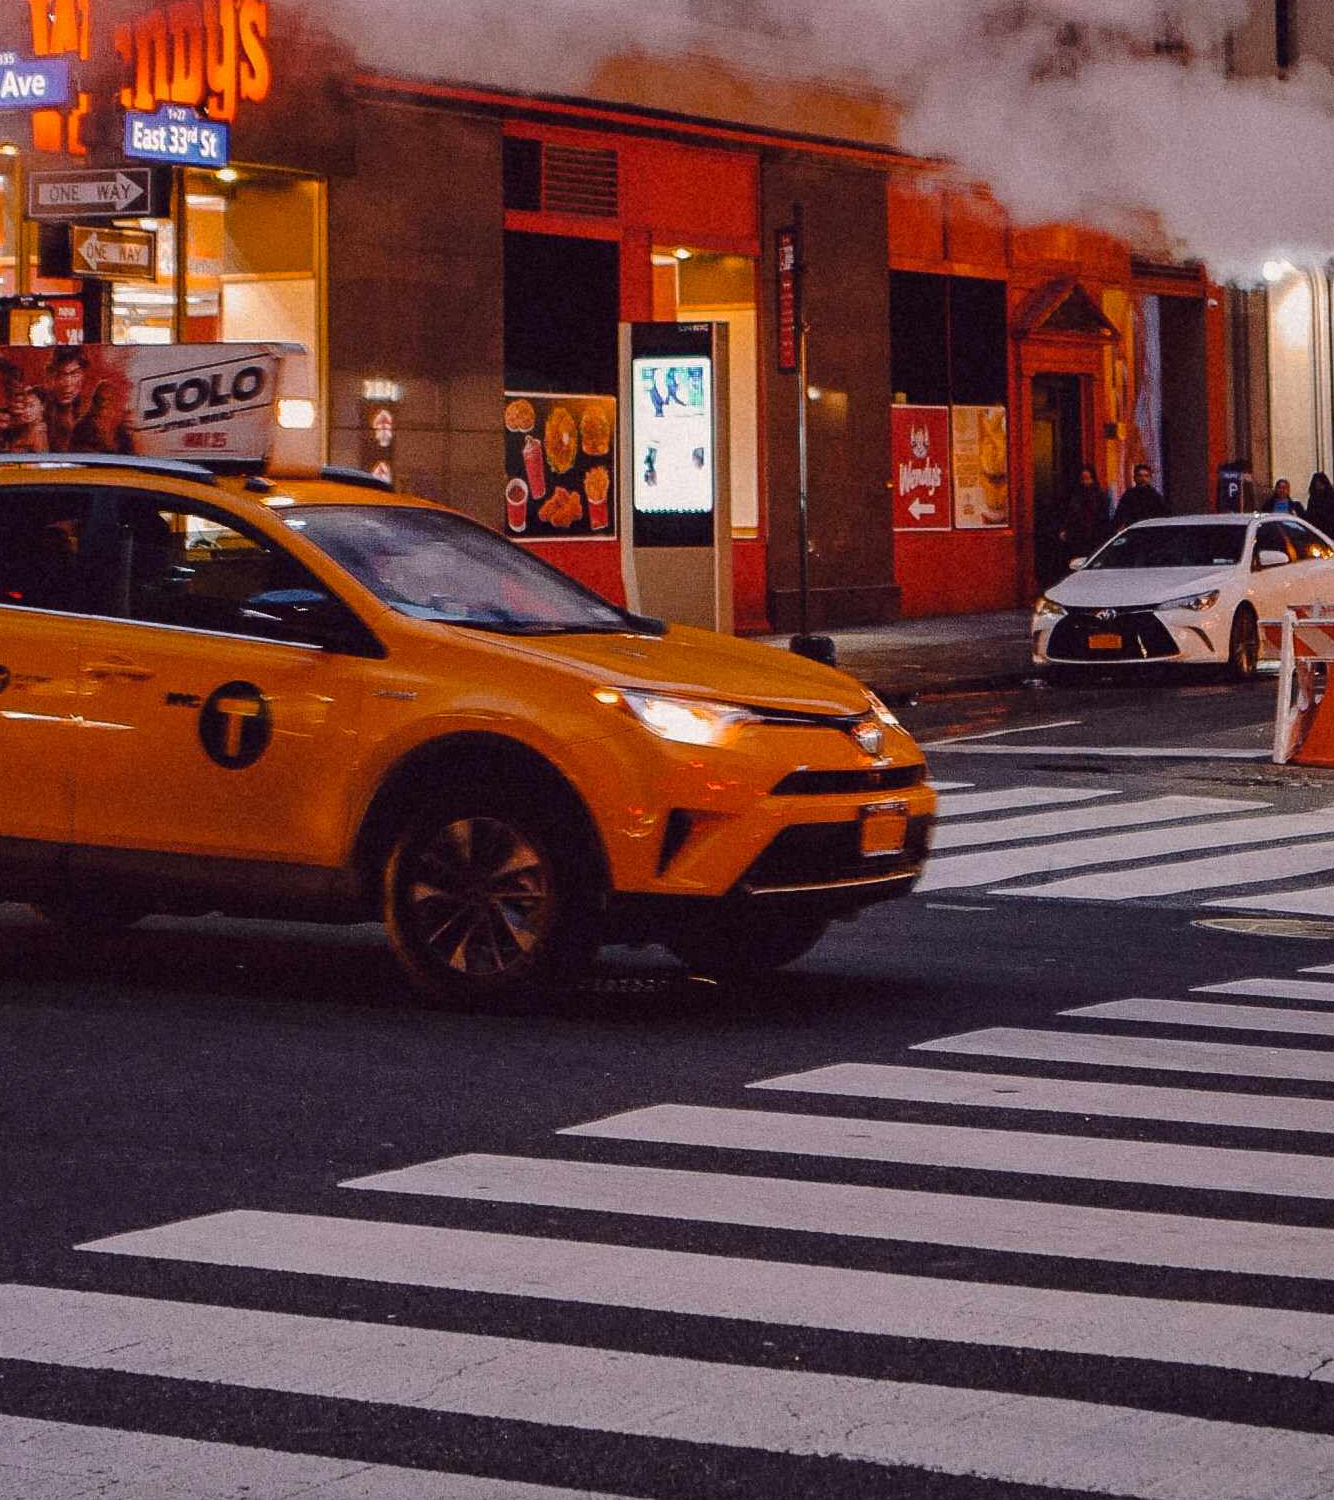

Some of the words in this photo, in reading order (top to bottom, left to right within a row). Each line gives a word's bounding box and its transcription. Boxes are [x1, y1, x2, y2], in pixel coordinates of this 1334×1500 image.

[0, 70, 46, 98] Ave
[132, 121, 166, 151] East
[168, 125, 197, 153] 33rd
[200, 132, 217, 158] St
[49, 186, 79, 202] ONE
[96, 184, 132, 201] WAY
[86, 243, 107, 260] ONE
[119, 245, 142, 262] WAY
[144, 366, 265, 420] SOLO
[1228, 482, 1239, 497] P
